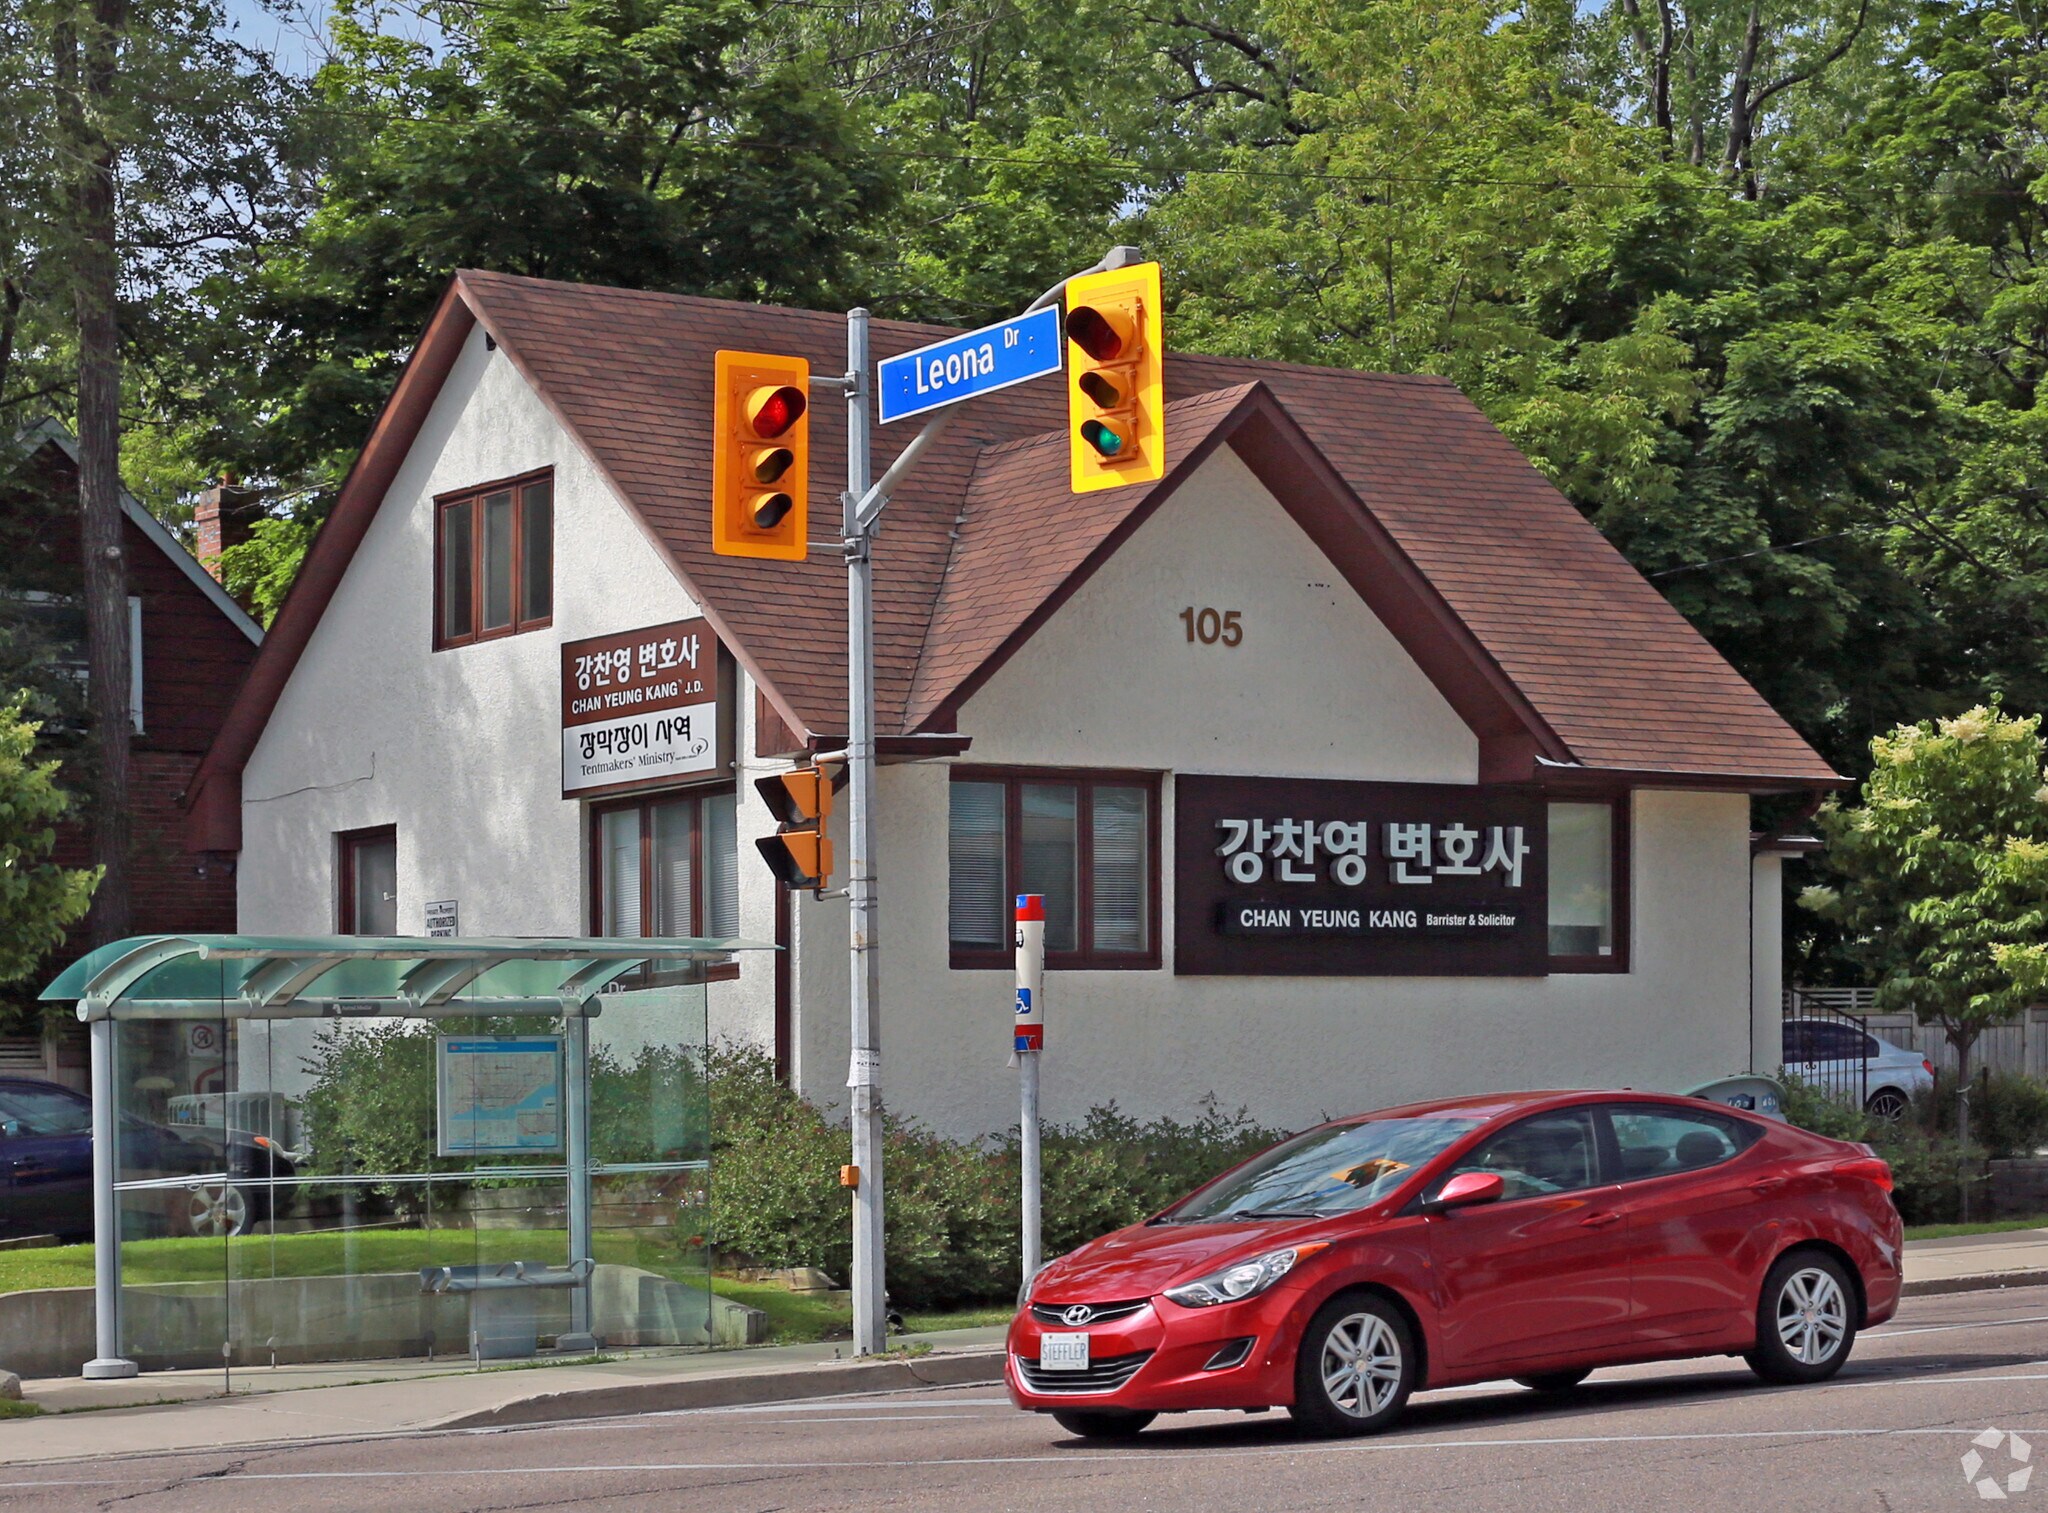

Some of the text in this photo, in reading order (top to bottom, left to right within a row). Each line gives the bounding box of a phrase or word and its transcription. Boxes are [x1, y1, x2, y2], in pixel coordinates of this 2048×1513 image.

[915, 327, 1020, 394] Leona Dr
[1179, 606, 1243, 647] 105
[574, 634, 700, 691] 강찬영 변호사
[571, 680, 704, 714] CHAN YEUNG KANG J.D.
[579, 715, 691, 760] 장막장이 사역
[638, 750, 676, 766] Ministry
[1215, 818, 1530, 888] 강찬영 변호사
[426, 916, 455, 928] AUTHORIZED
[1240, 909, 1515, 928] CHAN YEUNG KANG Barrister & Solicitor
[608, 981, 626, 994] Dr
